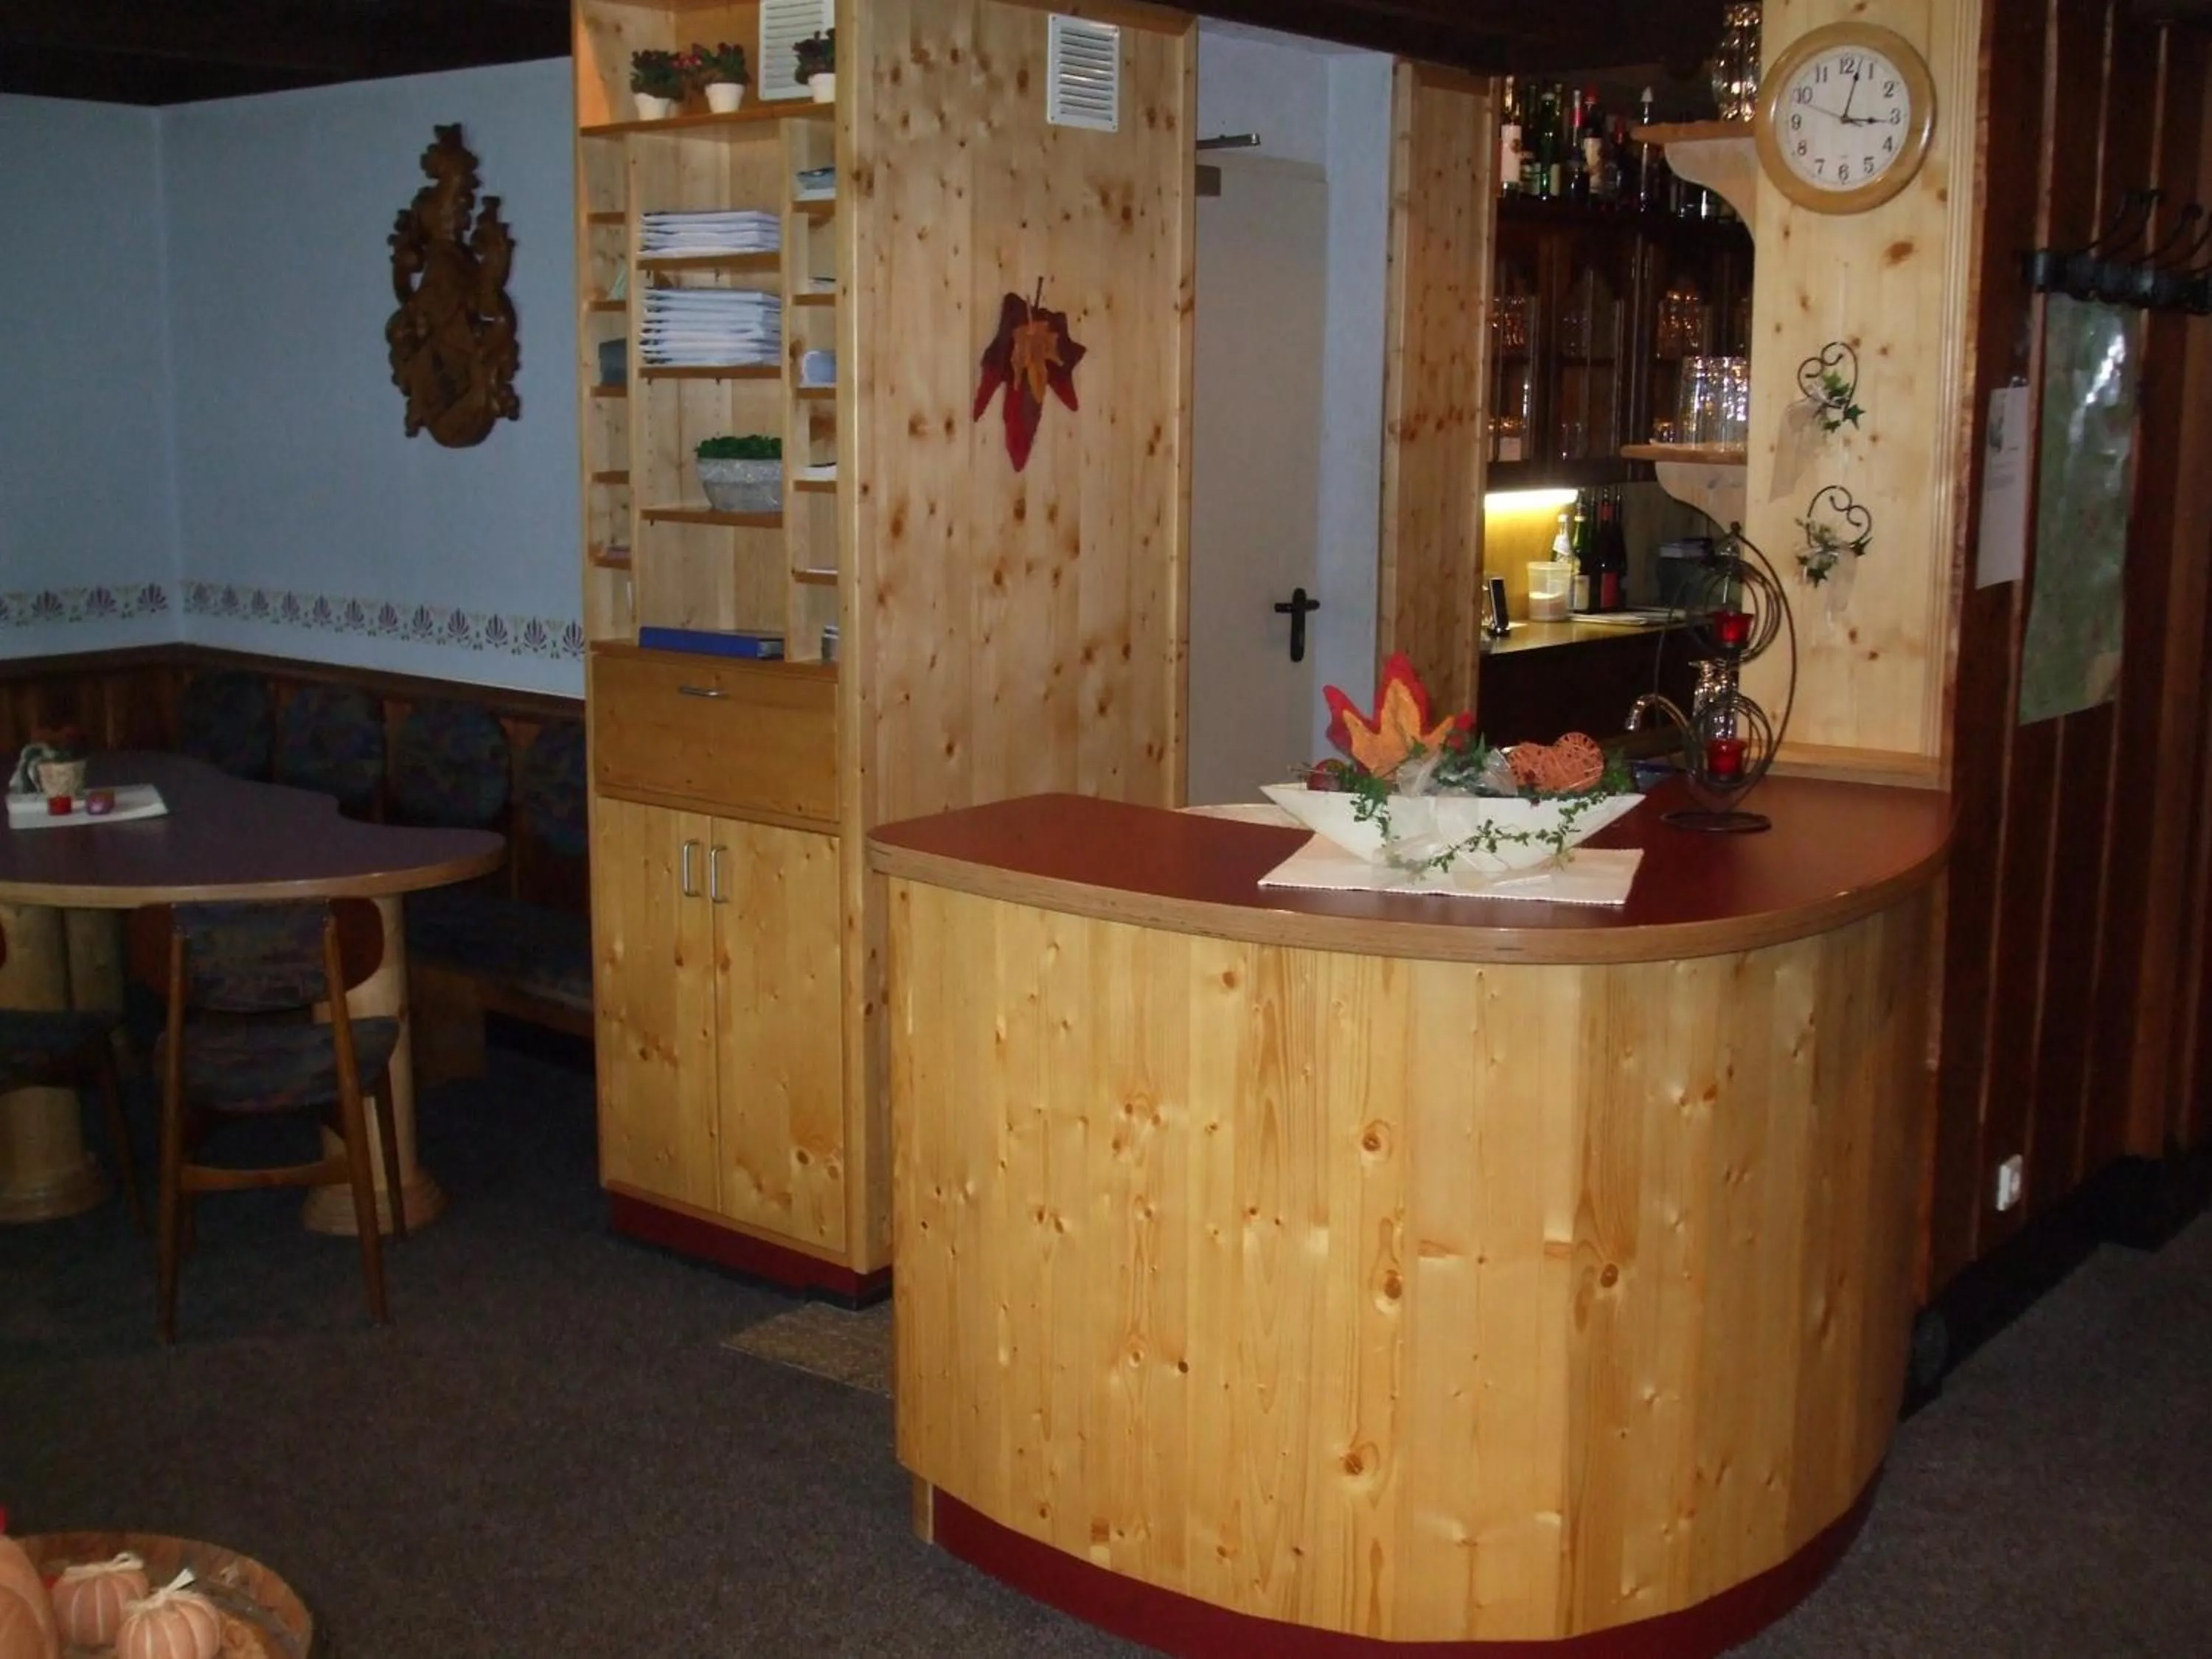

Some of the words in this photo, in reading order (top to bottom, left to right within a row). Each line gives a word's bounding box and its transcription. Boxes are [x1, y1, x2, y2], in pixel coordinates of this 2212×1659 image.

[1815, 66, 1828, 83] 11
[1839, 58, 1854, 74] 12
[1868, 63, 1874, 80] 1
[1793, 86, 1813, 104] 10
[1883, 81, 1895, 97] 2
[1791, 114, 1801, 130] 9
[1890, 108, 1901, 125] 3
[1797, 141, 1807, 156] 8
[1882, 136, 1893, 153] 4
[1815, 159, 1826, 175] 7
[1838, 164, 1849, 181] 6
[1863, 156, 1874, 173] 5
